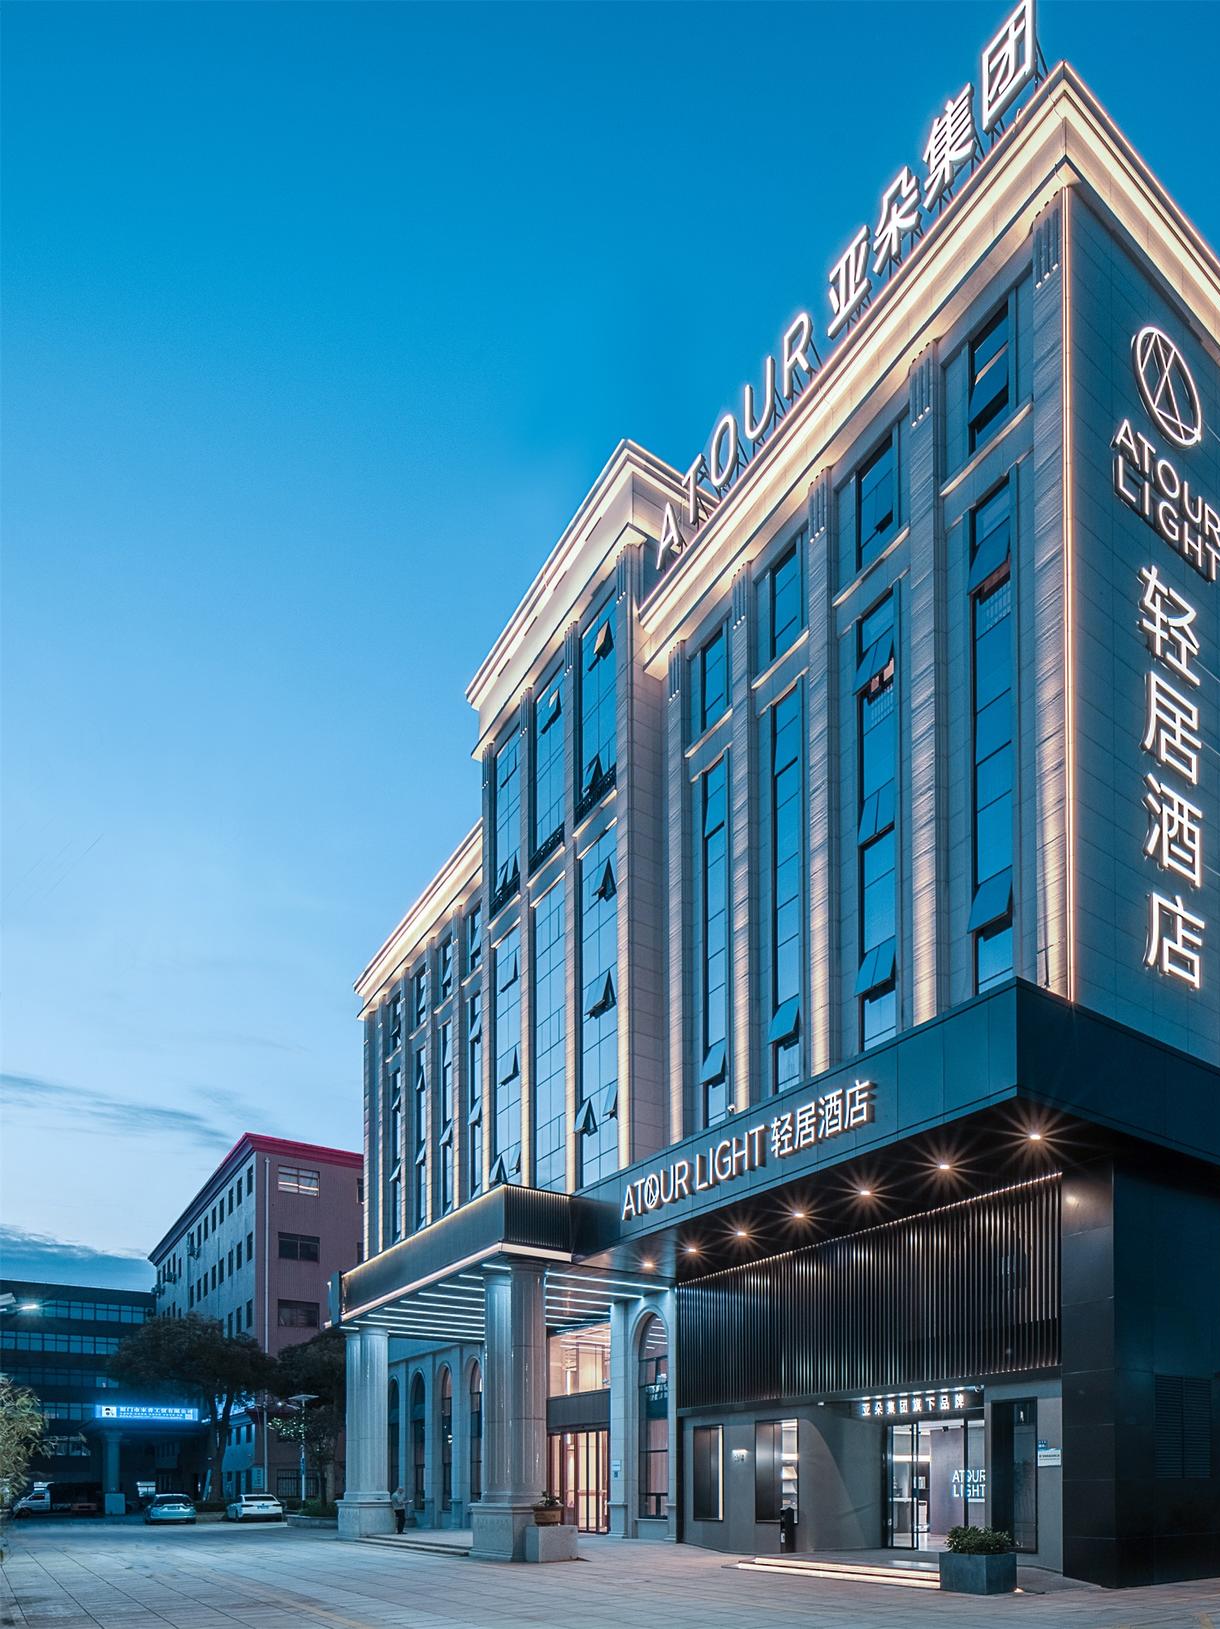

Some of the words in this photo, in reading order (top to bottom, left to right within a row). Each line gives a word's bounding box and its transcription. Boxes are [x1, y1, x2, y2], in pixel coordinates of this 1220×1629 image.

[656, 312, 813, 571] ATOUR
[827, 0, 1036, 338] 亚朵集团
[1140, 565, 1205, 990] 轻居酒店
[622, 1160, 691, 1221] ATOUR
[696, 1124, 765, 1191] LIGHT
[770, 1080, 870, 1158] 轻居酒店
[862, 1393, 965, 1417] 亚朵集团旗下品牌
